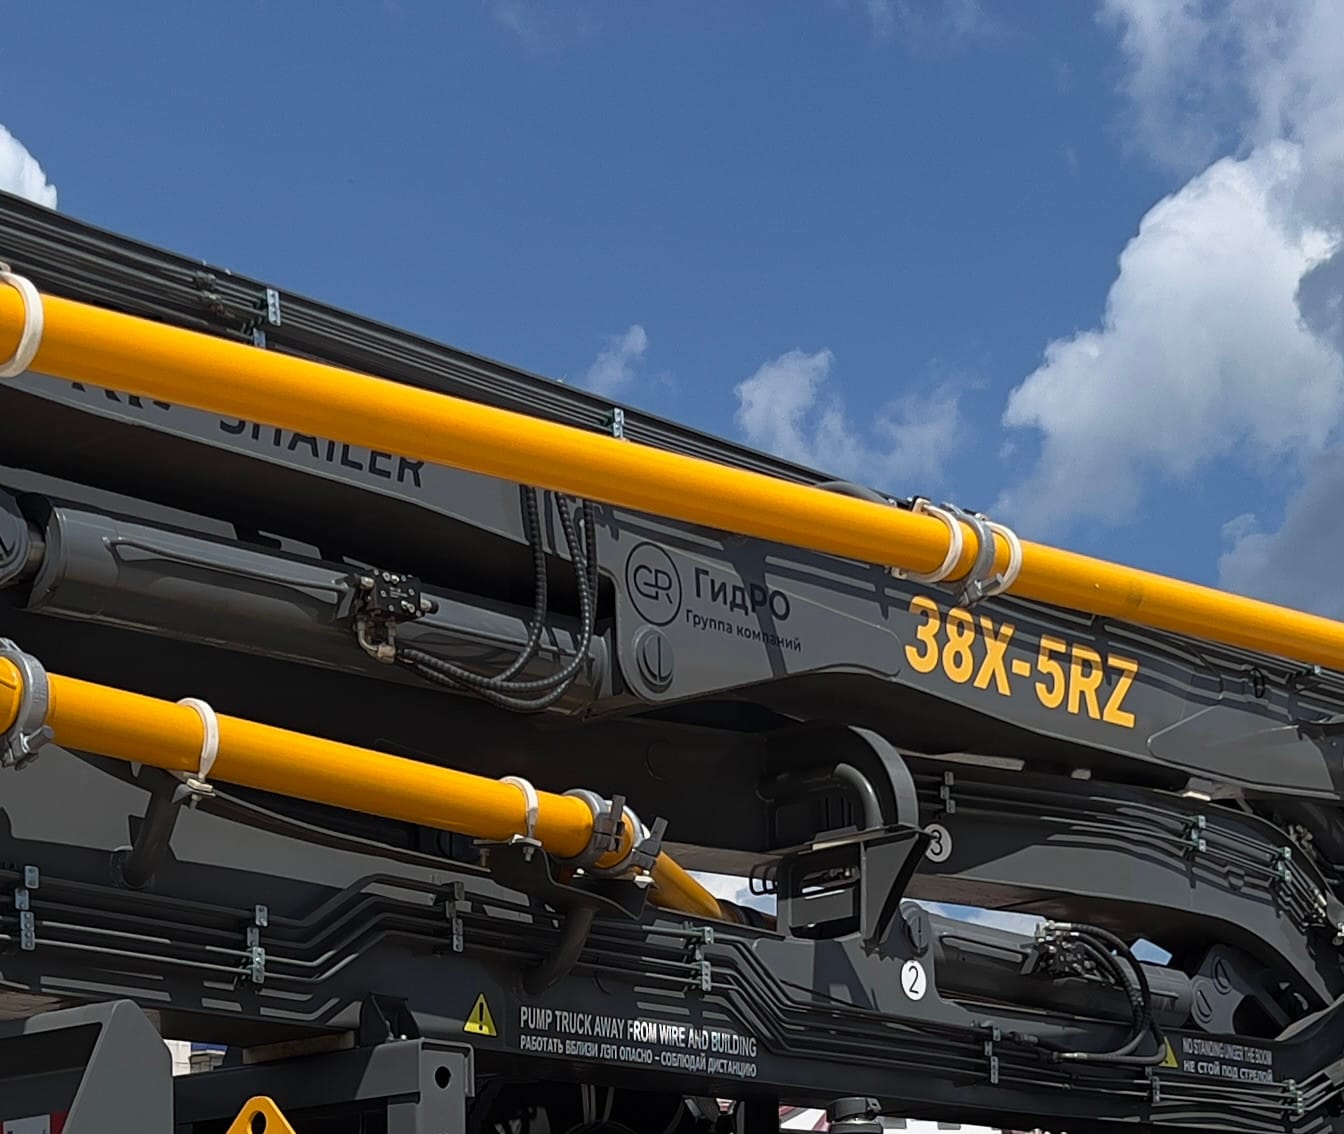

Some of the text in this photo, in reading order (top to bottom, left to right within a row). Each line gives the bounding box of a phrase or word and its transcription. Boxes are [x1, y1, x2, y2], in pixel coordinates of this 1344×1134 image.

[220, 418, 425, 488] ILER
[694, 567, 791, 621] ГидРО
[686, 609, 802, 652] Группа компаний
[905, 595, 1138, 729] 38X-5RZ
[928, 829, 943, 856] 3
[908, 965, 920, 994] 2
[520, 1006, 757, 1057] PUMP TRUCK AWAY FROM WIRE AND BUILDING
[1182, 1037, 1193, 1055] NO
[520, 1035, 563, 1053] РАБОТАТЬ
[565, 1040, 598, 1057] ВБЛИЗИ
[599, 1044, 618, 1060] ЛЭП
[619, 1046, 653, 1064] ОПАСНО
[660, 1052, 707, 1072] СОБЛЮДАЙ
[707, 1058, 757, 1078] ДИСТАНЦИЮ
[1183, 1060, 1196, 1073] НЕ
[1197, 1061, 1220, 1075] СТОЙ
[1221, 1065, 1238, 1078] ПОД
